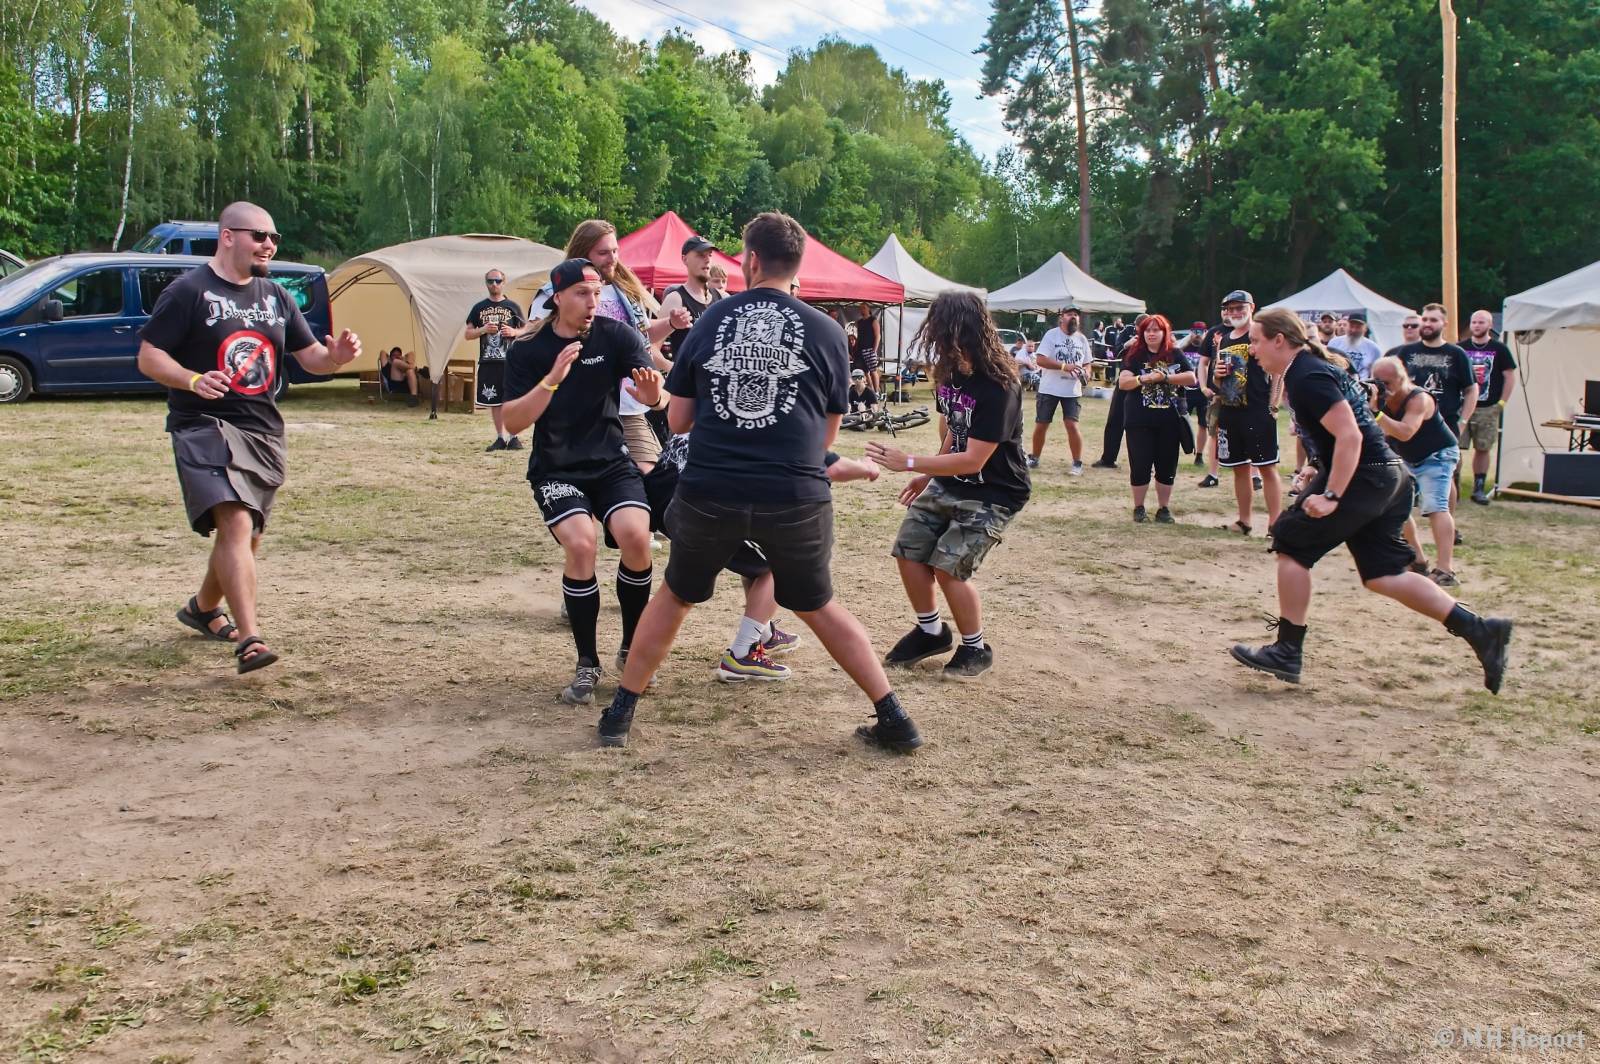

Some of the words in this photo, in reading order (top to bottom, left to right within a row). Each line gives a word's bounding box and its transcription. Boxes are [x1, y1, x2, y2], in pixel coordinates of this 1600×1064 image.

[714, 315, 734, 352] BURN
[733, 301, 778, 314] YOUR
[781, 306, 805, 354] HEAVEN
[711, 378, 730, 420] FLOOD
[735, 415, 778, 430] YOUR
[780, 381, 799, 415] HELL
